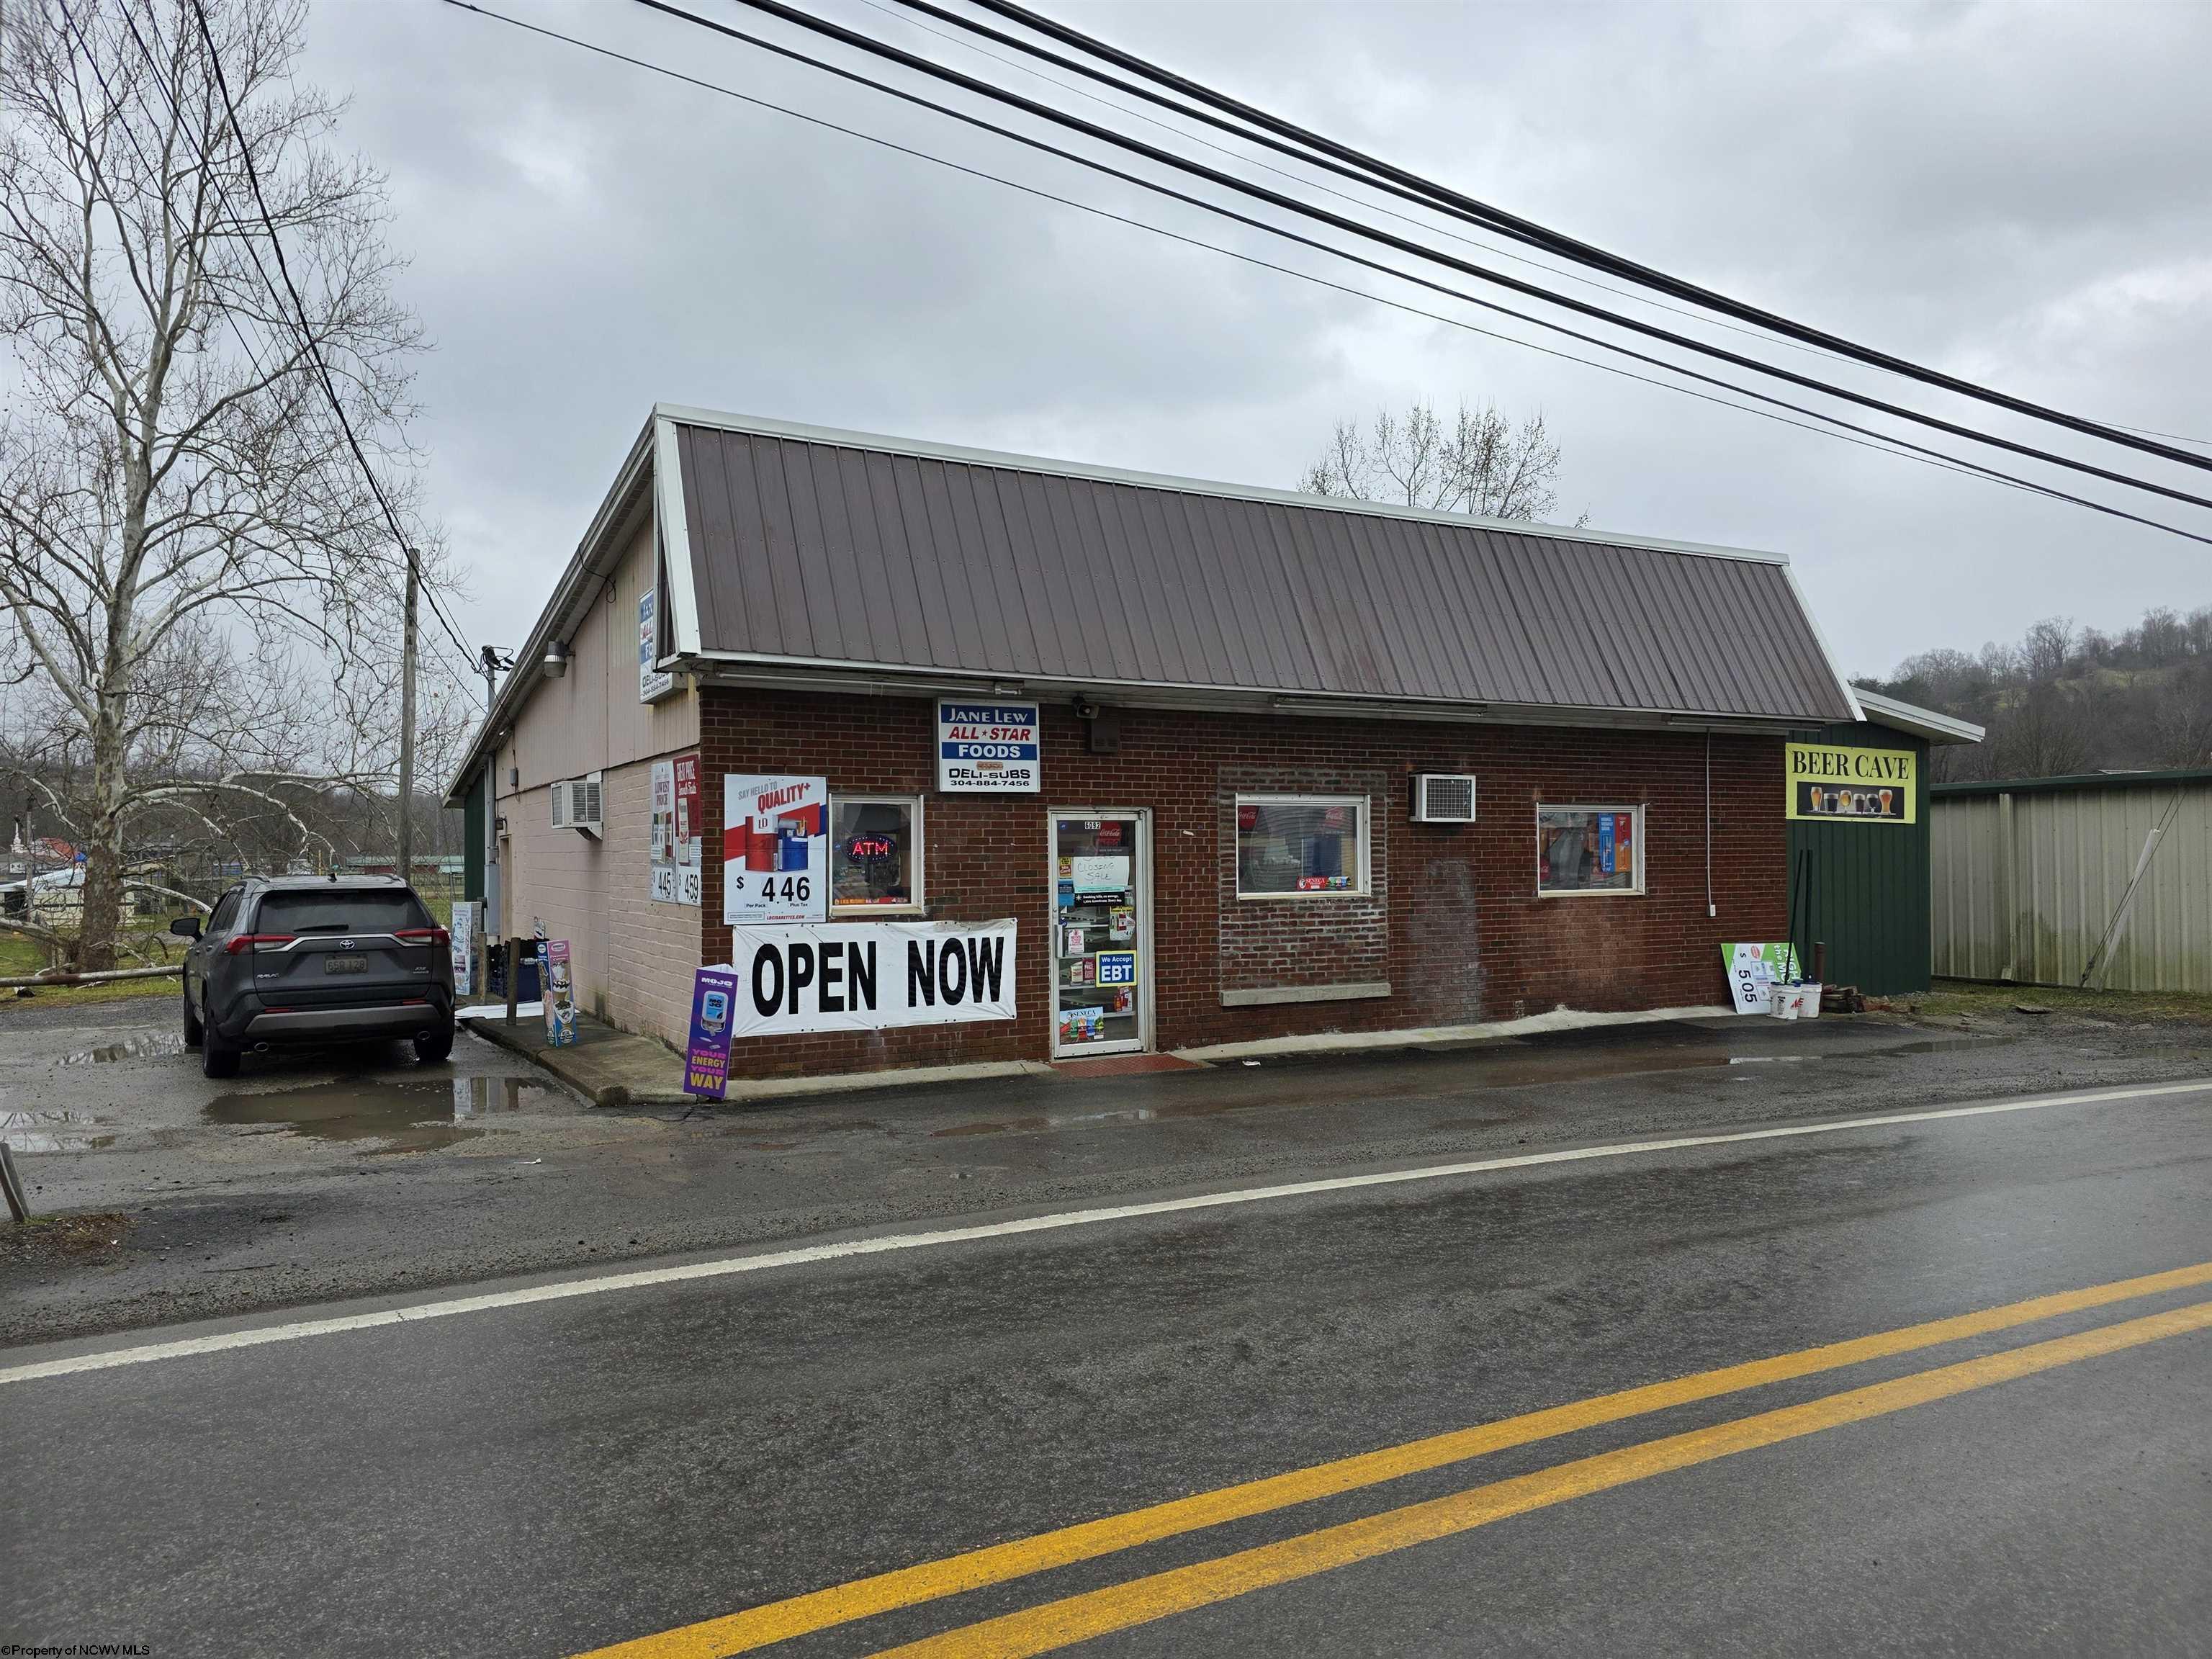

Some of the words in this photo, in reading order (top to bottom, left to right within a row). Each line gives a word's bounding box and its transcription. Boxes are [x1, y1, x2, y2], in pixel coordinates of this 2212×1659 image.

[642, 603, 653, 619] JAN
[949, 708, 991, 722] JANE
[994, 709, 1028, 723] LEW
[948, 726, 980, 740] ALL
[989, 727, 1031, 741] STAR
[958, 744, 1021, 758] FOODS
[1791, 750, 1850, 777] BEER
[1855, 755, 1909, 780] CAVE
[948, 768, 1030, 779] DELI-SUBS
[738, 788, 750, 800] SAY
[750, 783, 769, 796] HELLO
[770, 781, 778, 791] TO
[853, 842, 888, 855] ATM
[737, 876, 744, 890] $
[752, 940, 877, 1017] OPEN
[907, 936, 1004, 1008] NOW
[1101, 965, 1132, 981] EBT
[701, 977, 733, 986] MOJO
[692, 1048, 727, 1058] YOUR
[691, 1056, 726, 1069] ENERGY
[691, 1066, 724, 1076] YOUR
[690, 1072, 724, 1090] WAY
